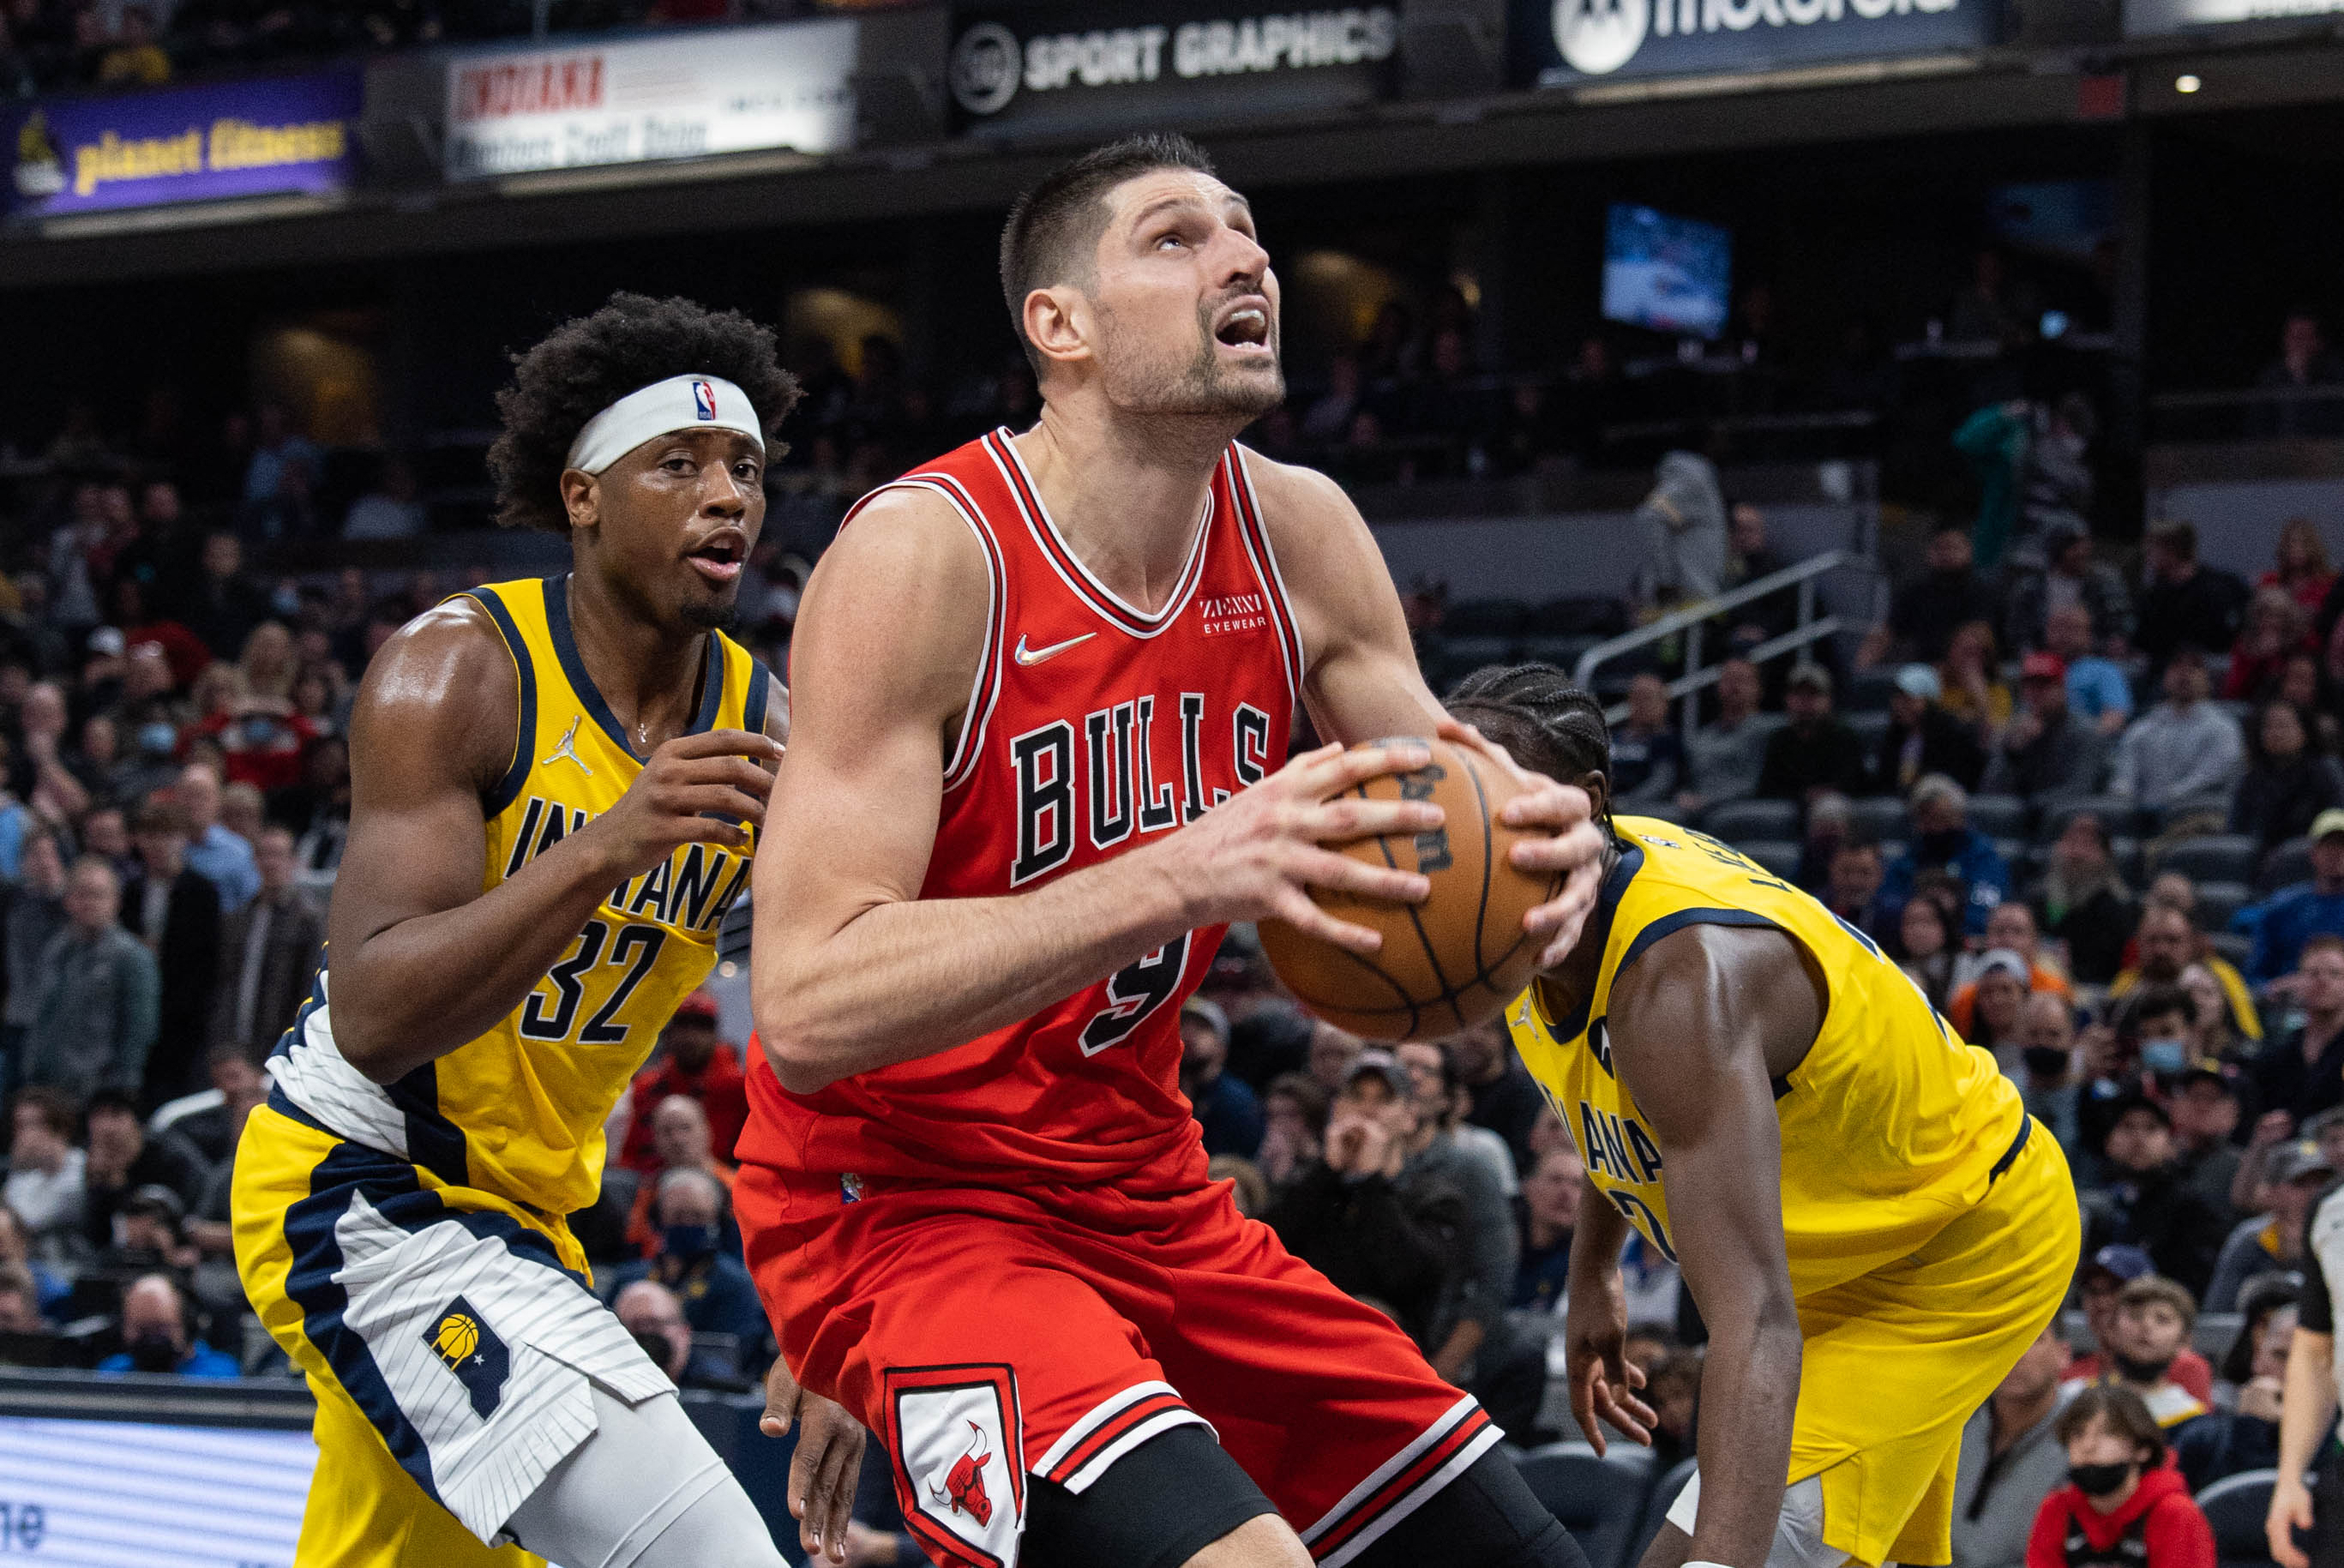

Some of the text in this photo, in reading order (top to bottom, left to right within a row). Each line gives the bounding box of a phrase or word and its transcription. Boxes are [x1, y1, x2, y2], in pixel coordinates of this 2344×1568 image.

[1025, 25, 1169, 90] SPORT
[1173, 8, 1397, 78] GRAPHICS
[1199, 593, 1262, 618] ZENNI
[1204, 616, 1266, 634] EYEWEAR
[1010, 692, 1271, 881] BULLS
[519, 919, 667, 1045] 32
[1078, 928, 1193, 1059] 9
